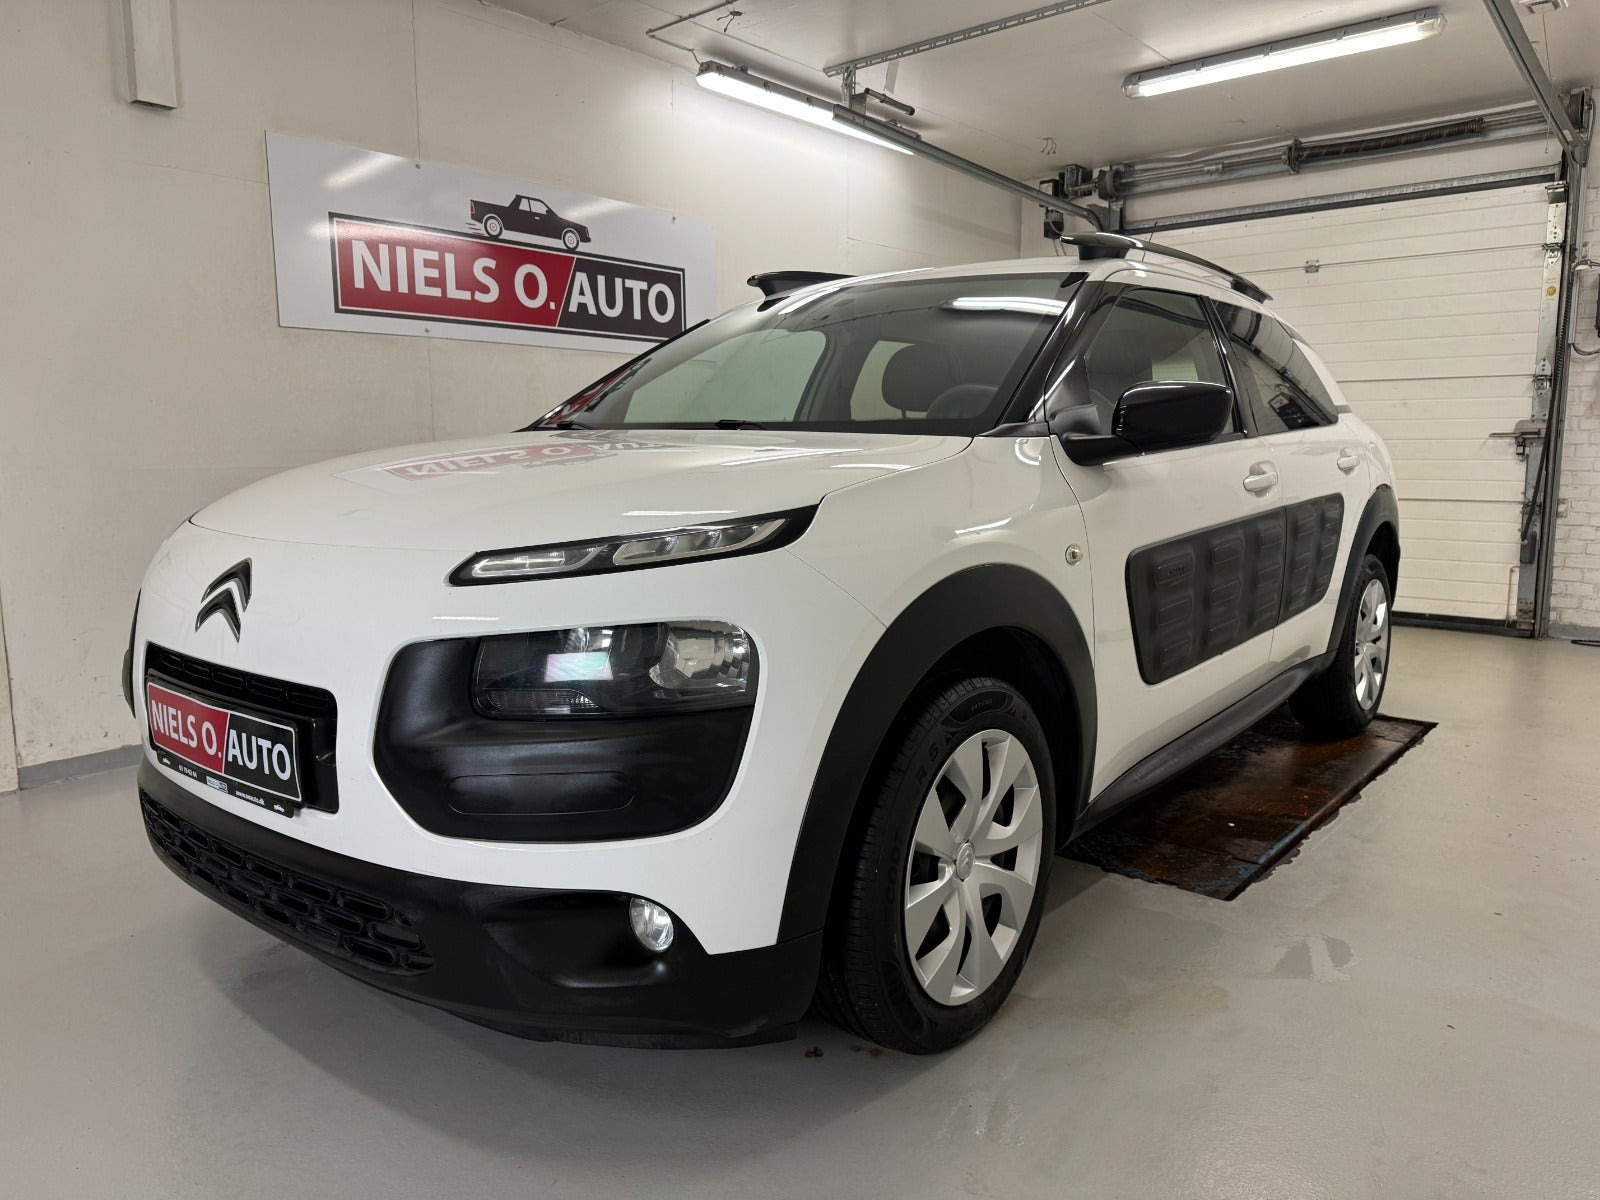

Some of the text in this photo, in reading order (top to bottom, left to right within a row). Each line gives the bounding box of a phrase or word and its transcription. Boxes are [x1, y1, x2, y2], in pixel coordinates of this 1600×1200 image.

[351, 239, 675, 325] NIELS O. AUTO
[151, 699, 291, 781] NIELS O. AUTO
